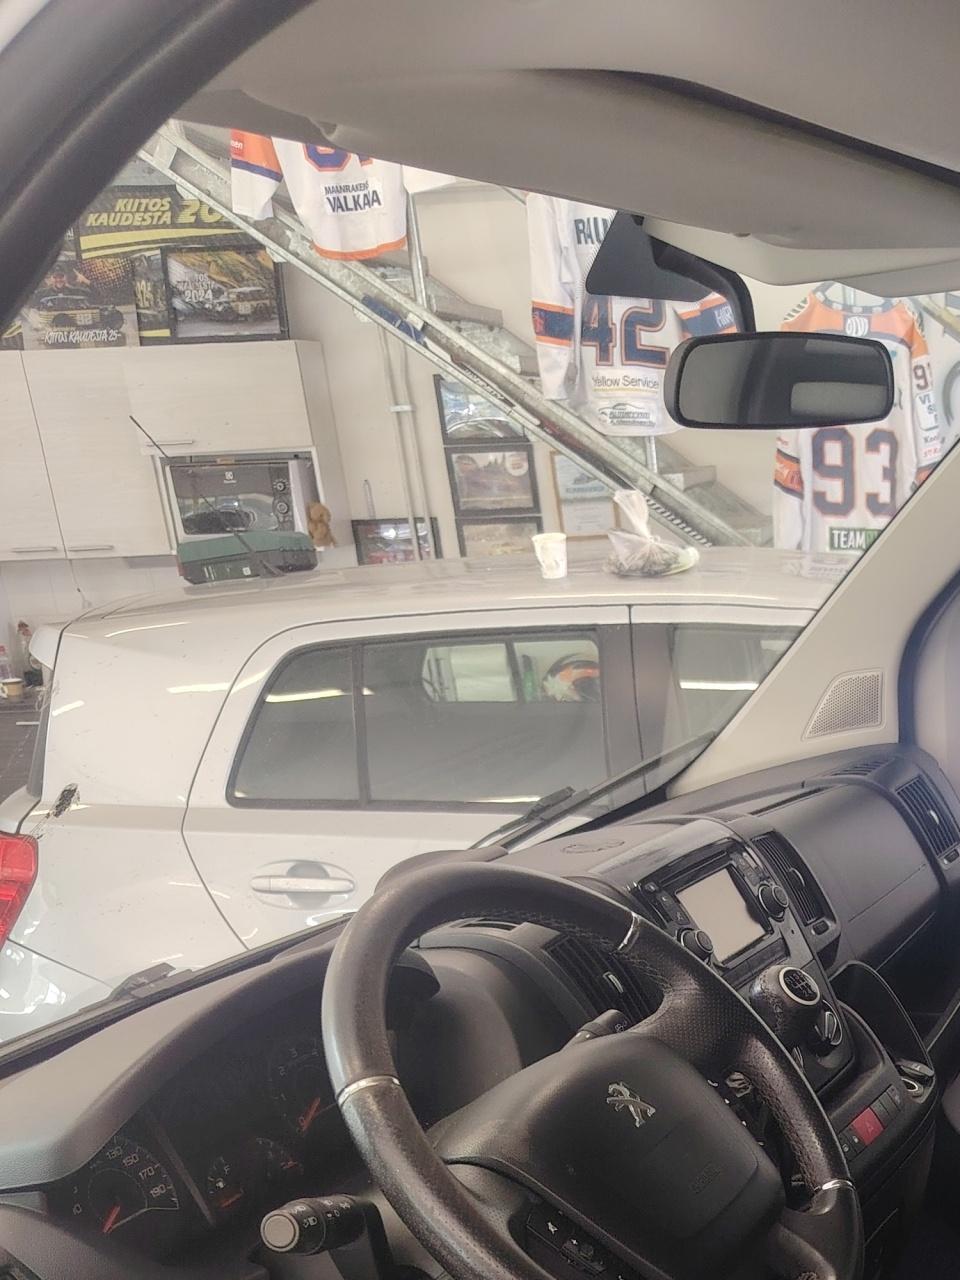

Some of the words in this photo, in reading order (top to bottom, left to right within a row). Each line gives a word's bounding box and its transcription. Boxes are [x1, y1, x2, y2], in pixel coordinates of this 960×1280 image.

[114, 197, 171, 212] KIITOS
[85, 211, 172, 227] KAUDESTA
[184, 288, 213, 303] 2024
[580, 292, 670, 369] 42
[621, 374, 660, 390] Service
[810, 426, 899, 518] 93
[121, 1153, 140, 1169] 150
[137, 1166, 156, 1181] 170
[149, 1184, 168, 1200] 190
